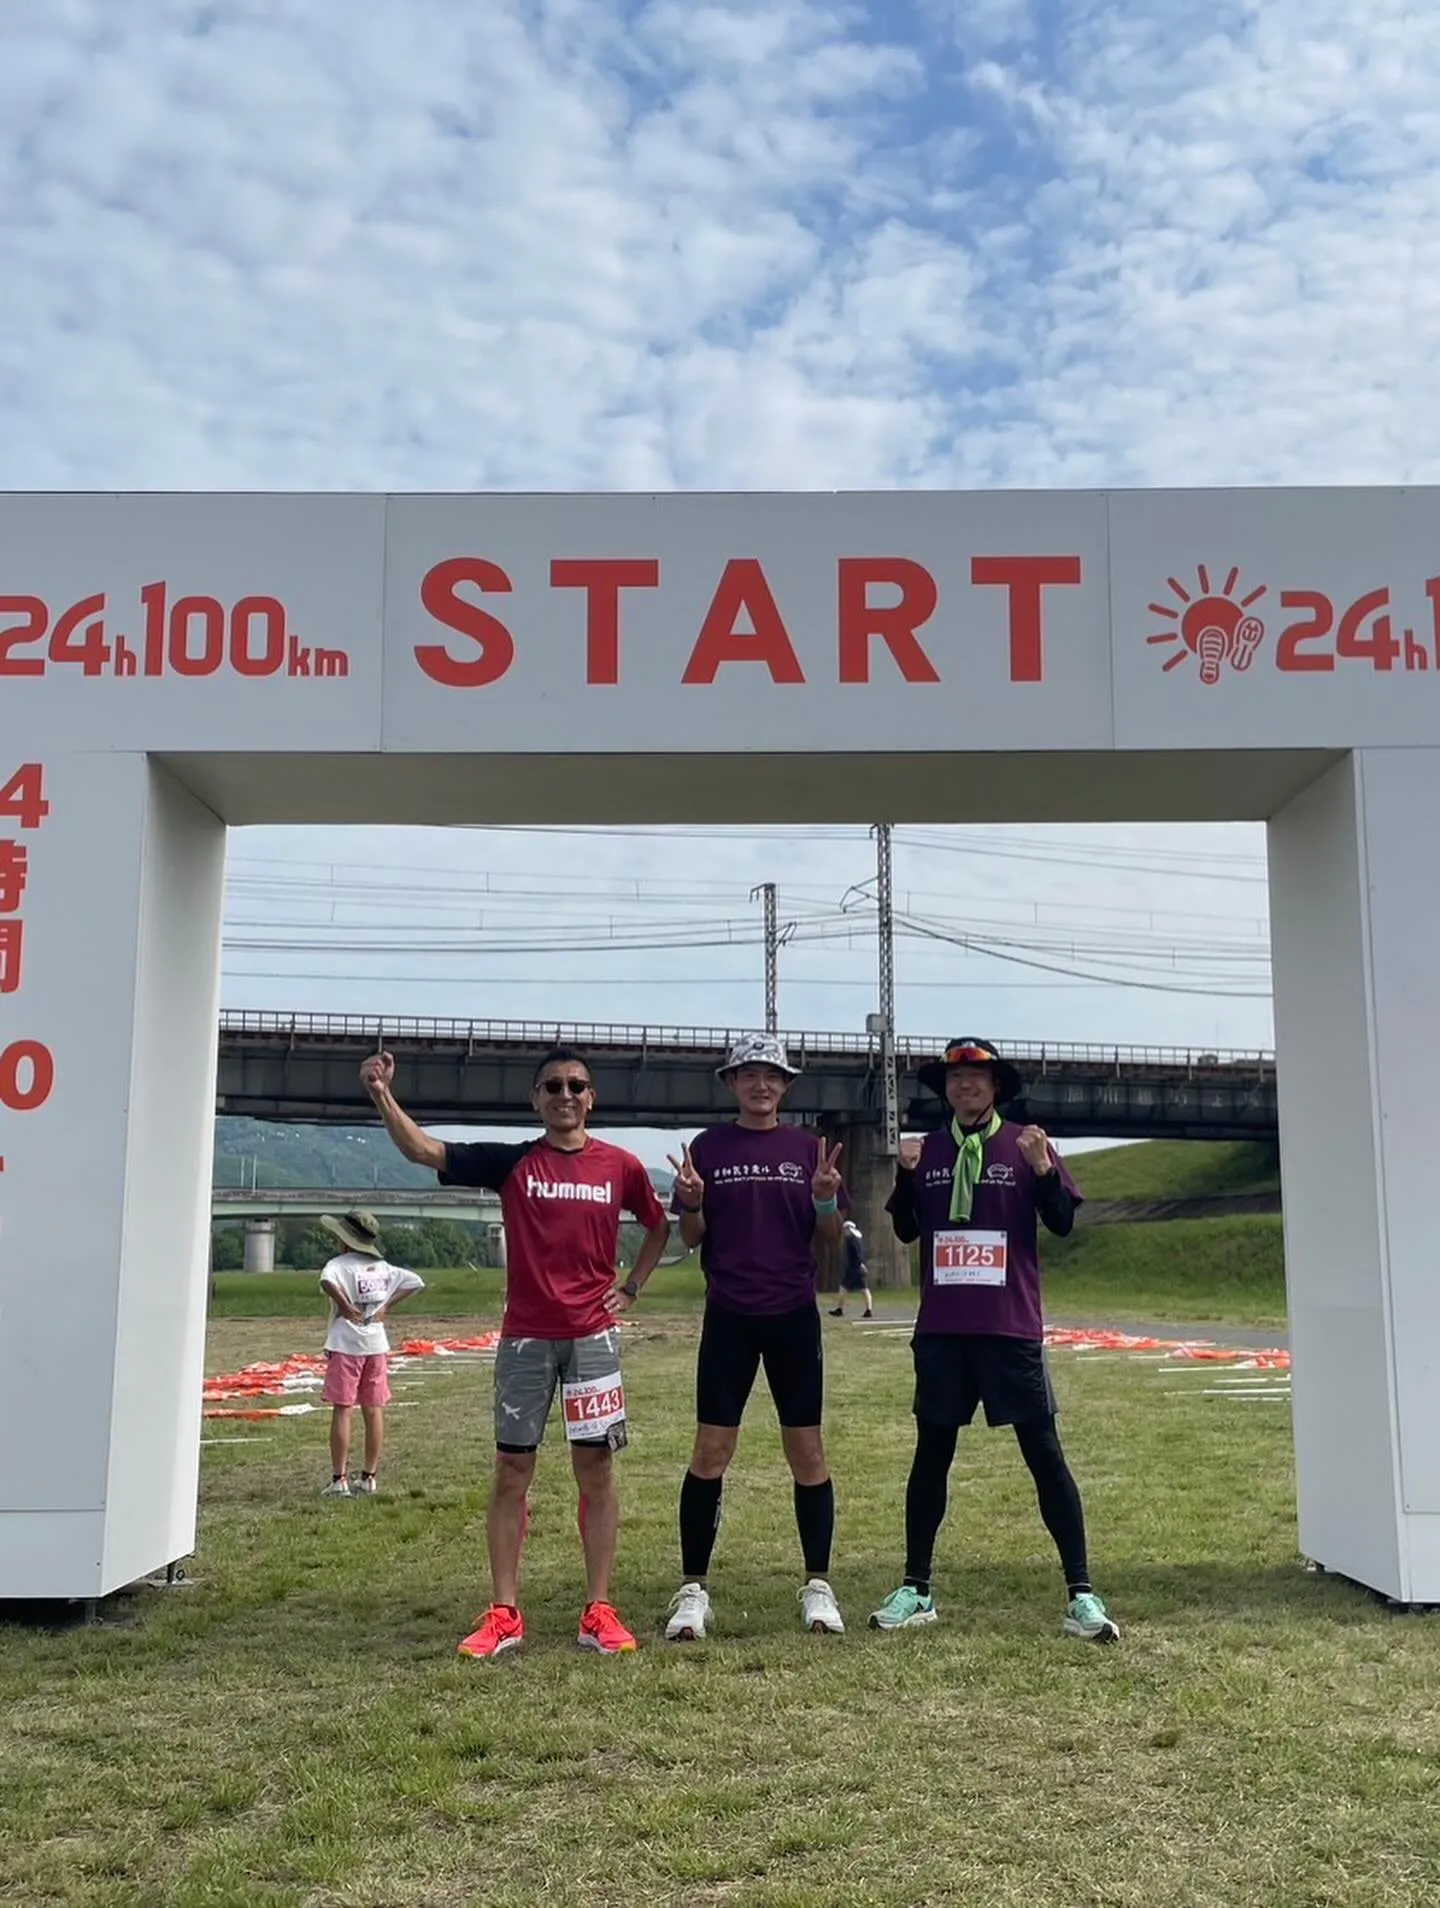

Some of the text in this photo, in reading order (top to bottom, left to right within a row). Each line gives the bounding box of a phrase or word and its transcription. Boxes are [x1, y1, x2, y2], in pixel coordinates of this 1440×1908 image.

[415, 557, 1081, 687] START
[526, 1174, 612, 1204] hummel
[944, 1245, 994, 1266] 1125
[574, 1389, 620, 1419] 1443
